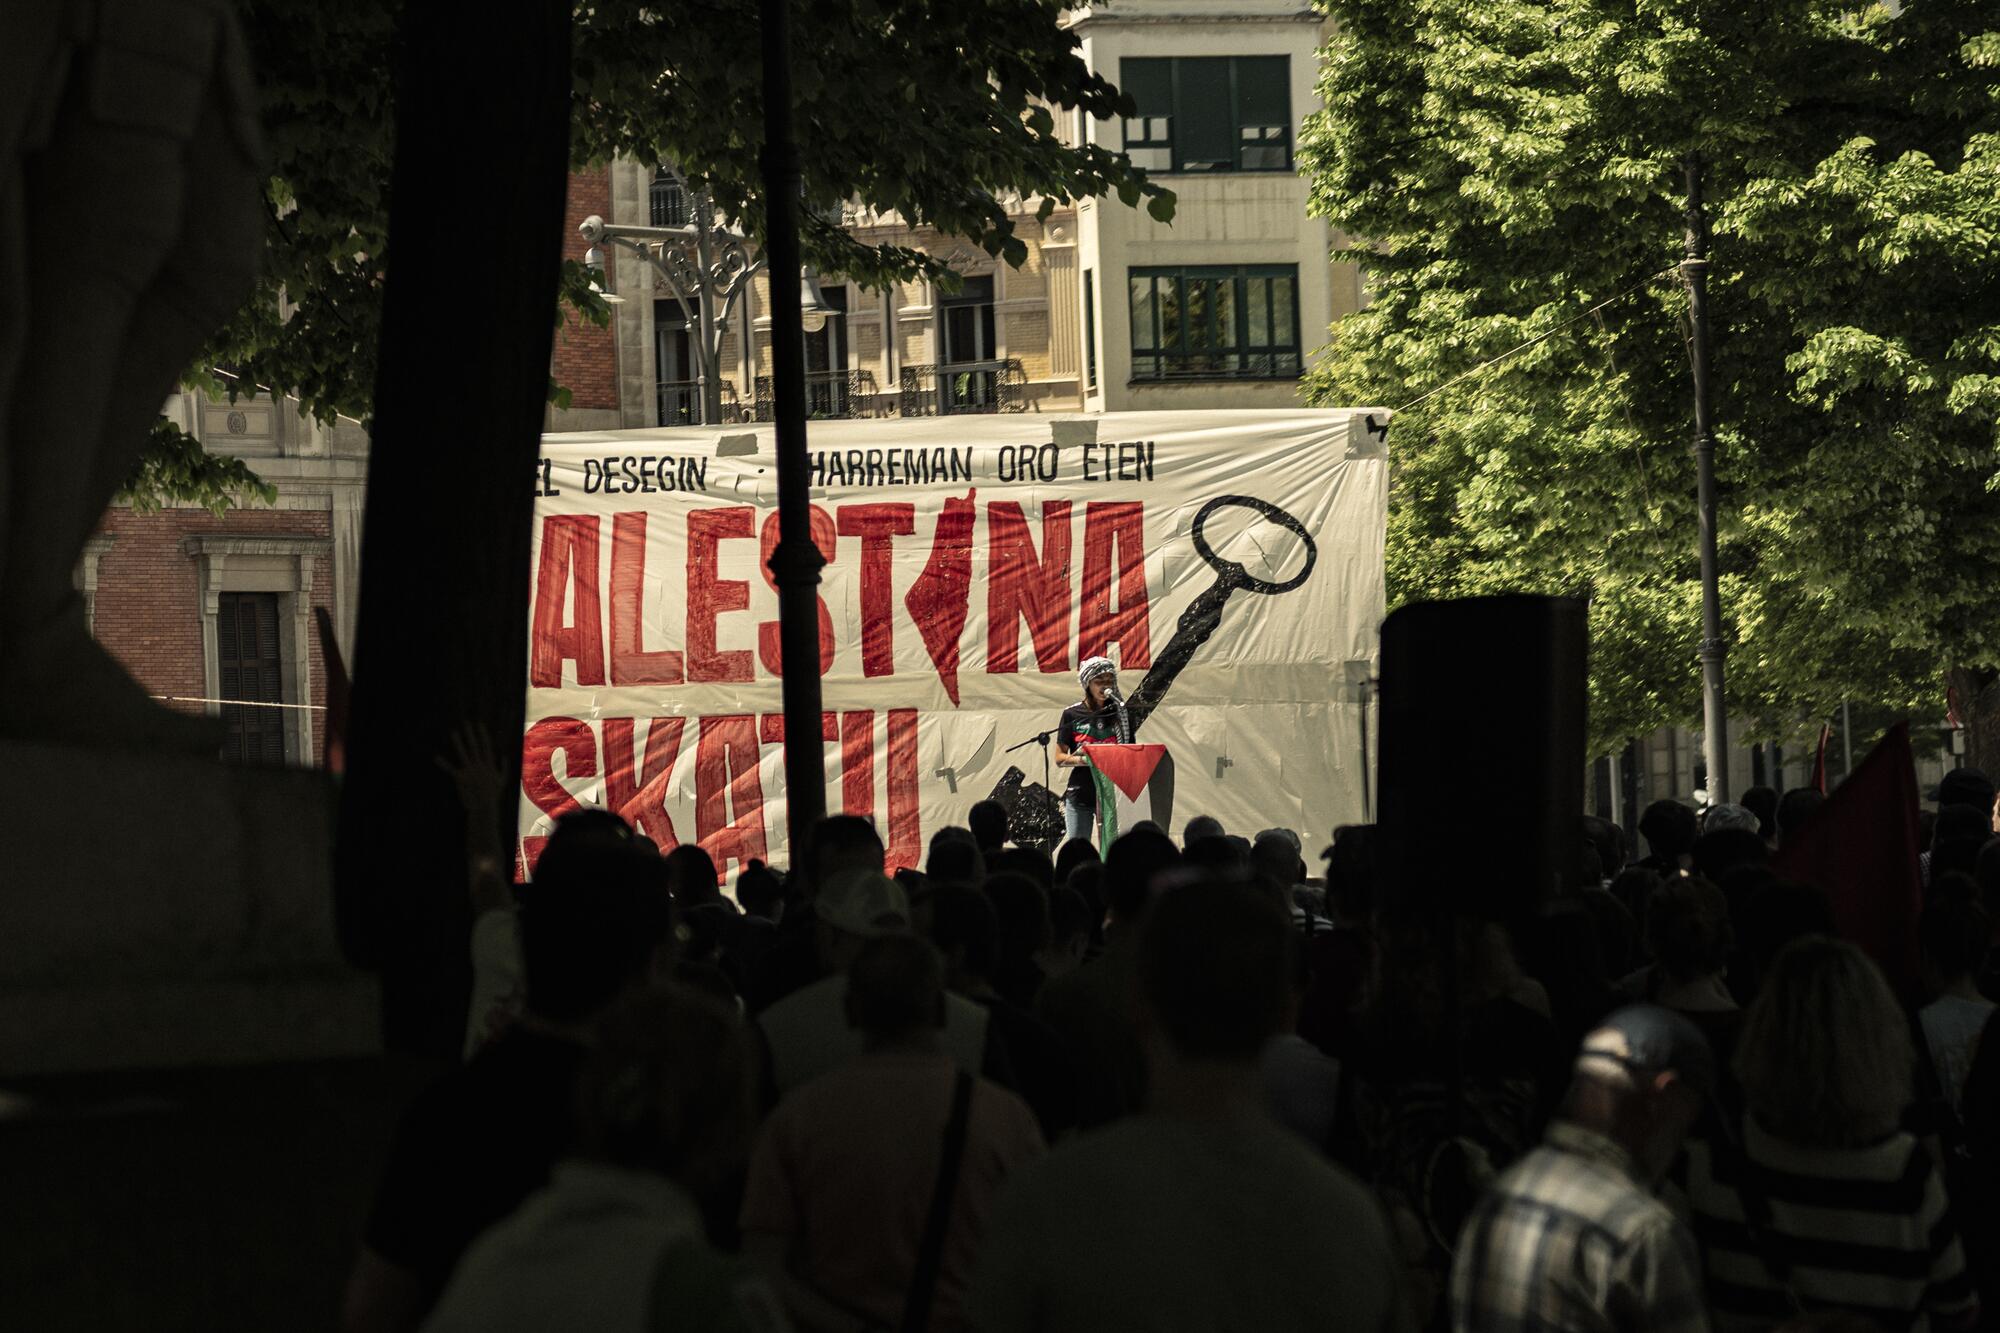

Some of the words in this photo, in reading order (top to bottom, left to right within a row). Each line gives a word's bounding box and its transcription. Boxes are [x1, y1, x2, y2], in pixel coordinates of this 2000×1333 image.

[584, 456, 708, 494] DESEGIN
[807, 446, 973, 486] HARREMAN
[999, 443, 1060, 482] ORO
[1083, 441, 1155, 482] ETEN
